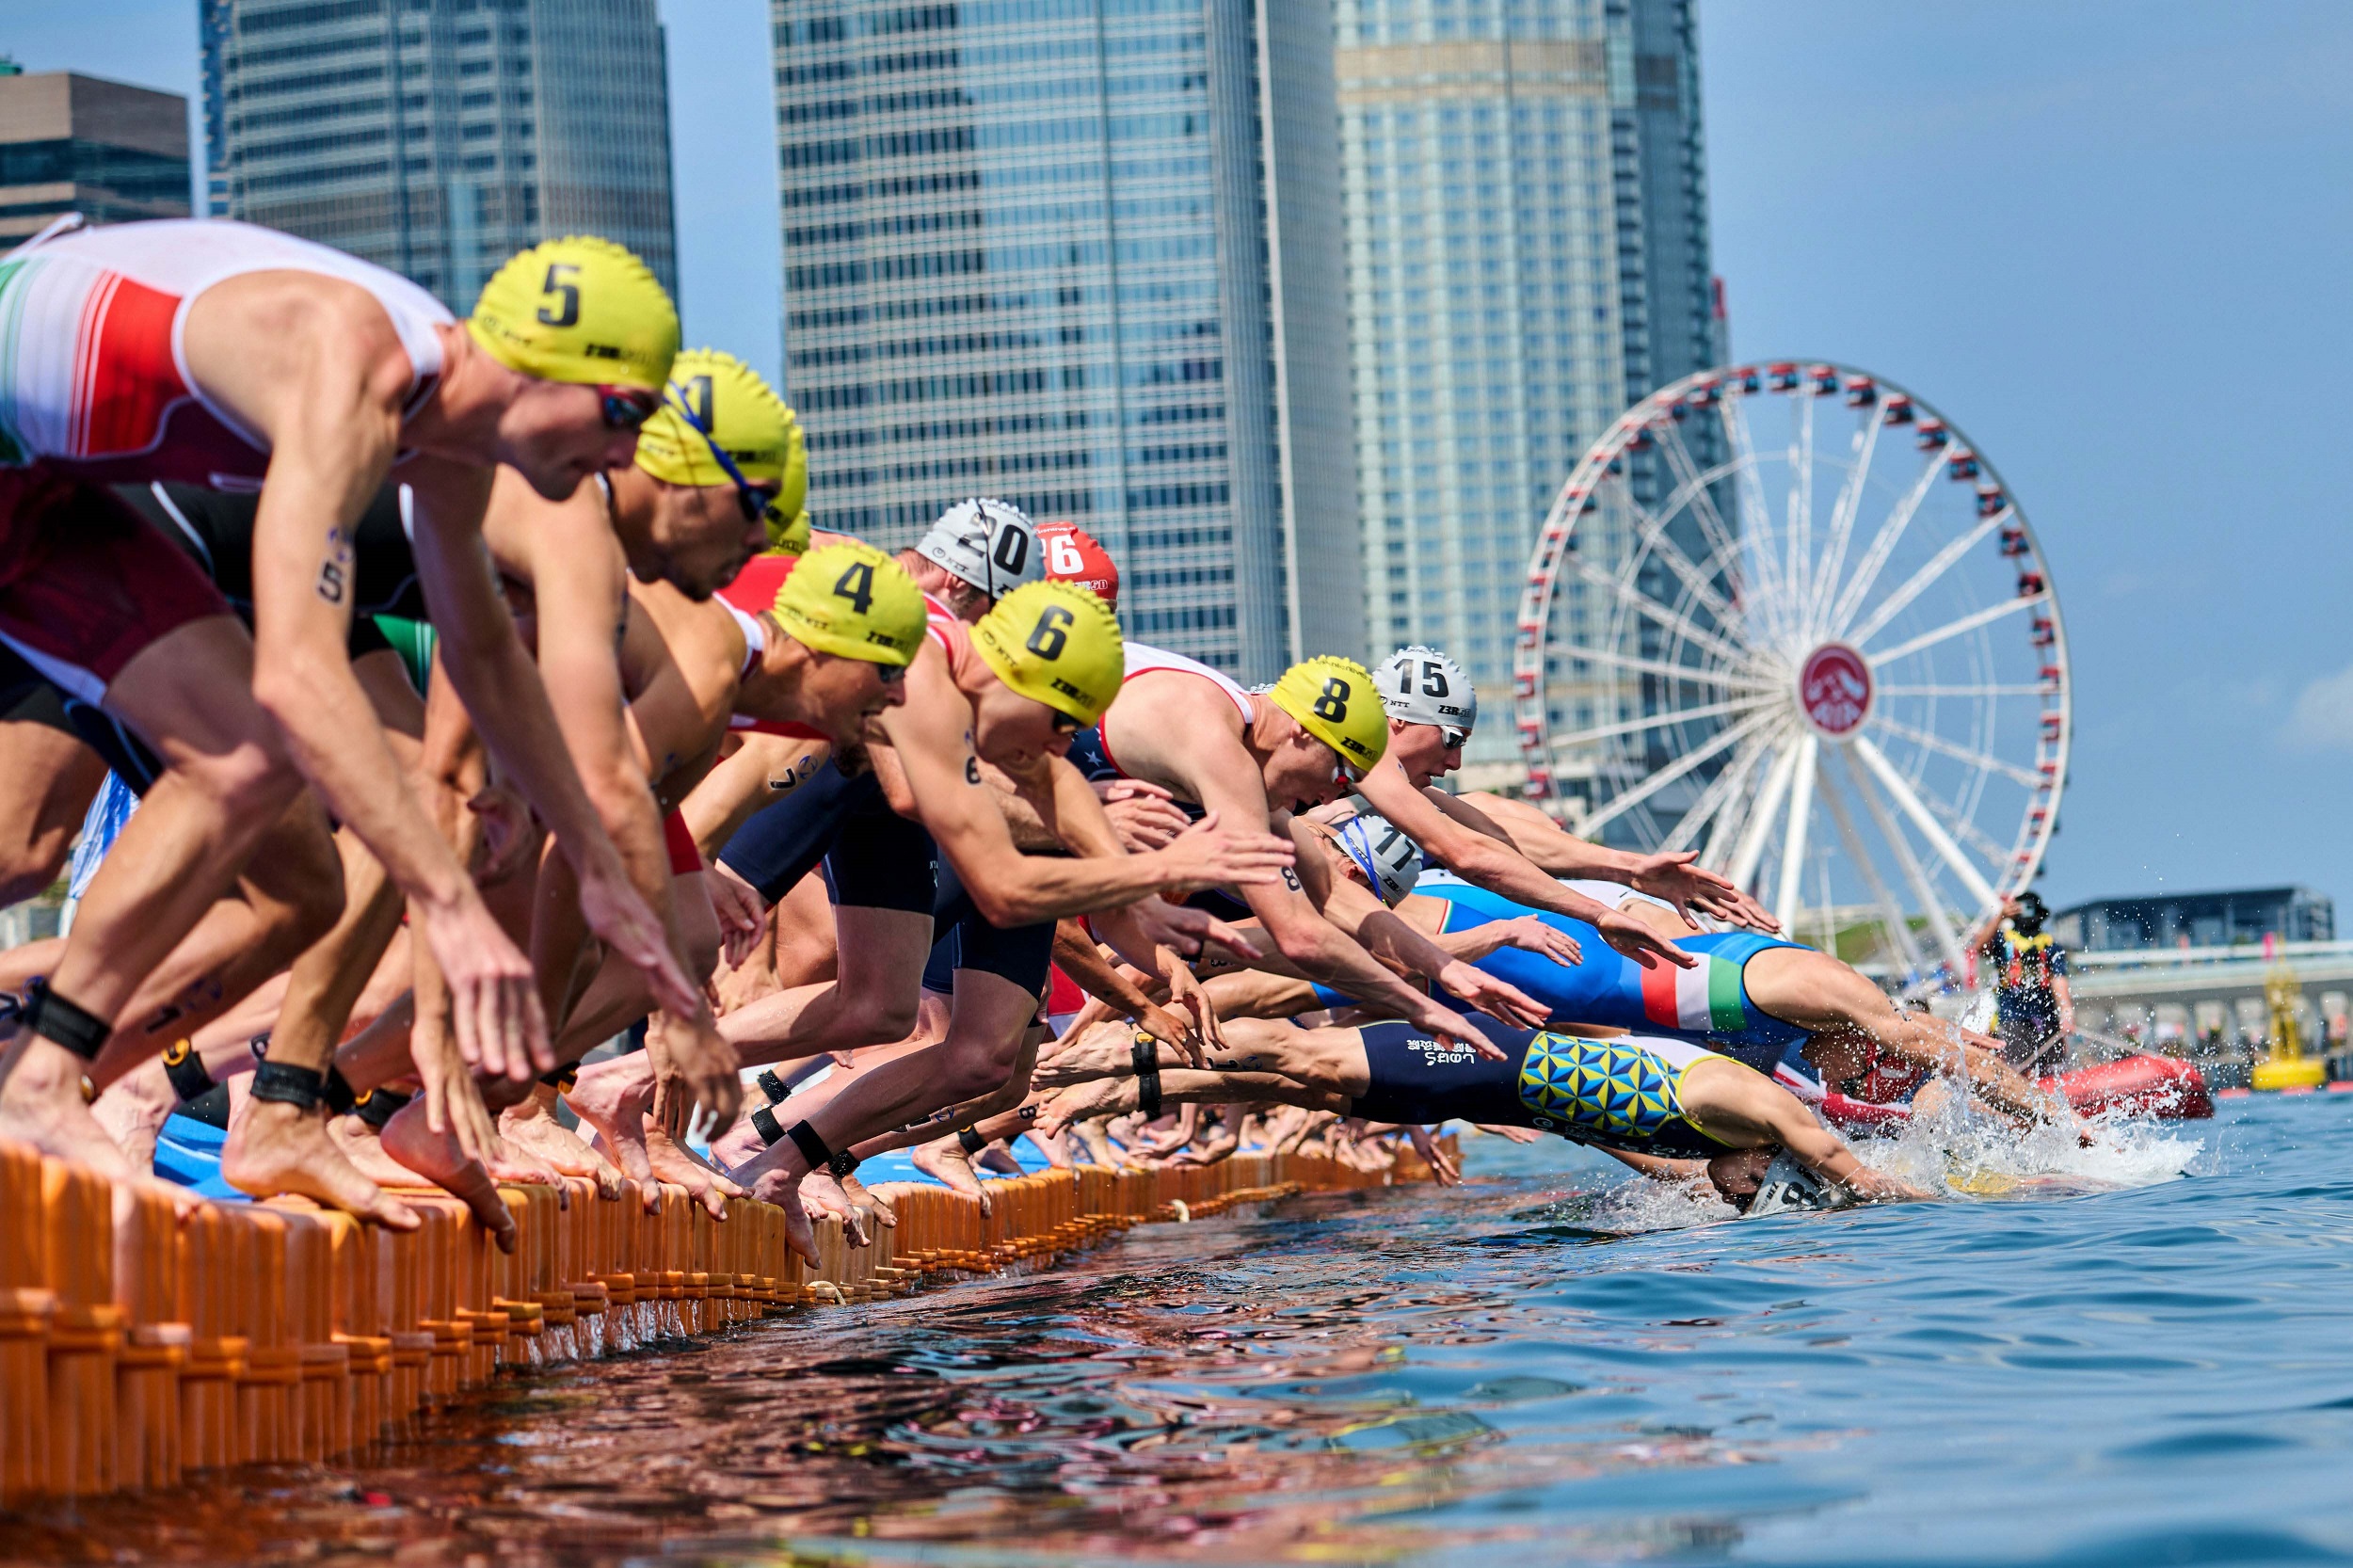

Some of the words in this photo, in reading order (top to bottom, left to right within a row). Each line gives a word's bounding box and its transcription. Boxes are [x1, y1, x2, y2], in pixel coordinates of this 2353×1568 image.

[536, 264, 581, 328] 5
[956, 511, 1029, 576] 20
[1040, 534, 1084, 575] 6
[318, 561, 343, 603] 5
[834, 562, 874, 616] 4
[1026, 604, 1075, 662] 6
[1393, 658, 1449, 698] 15
[1313, 677, 1352, 724] 8
[1390, 700, 1410, 709] NTT
[770, 767, 797, 789] 7
[1281, 866, 1301, 892] 8
[1424, 1051, 1475, 1066] しのはら
